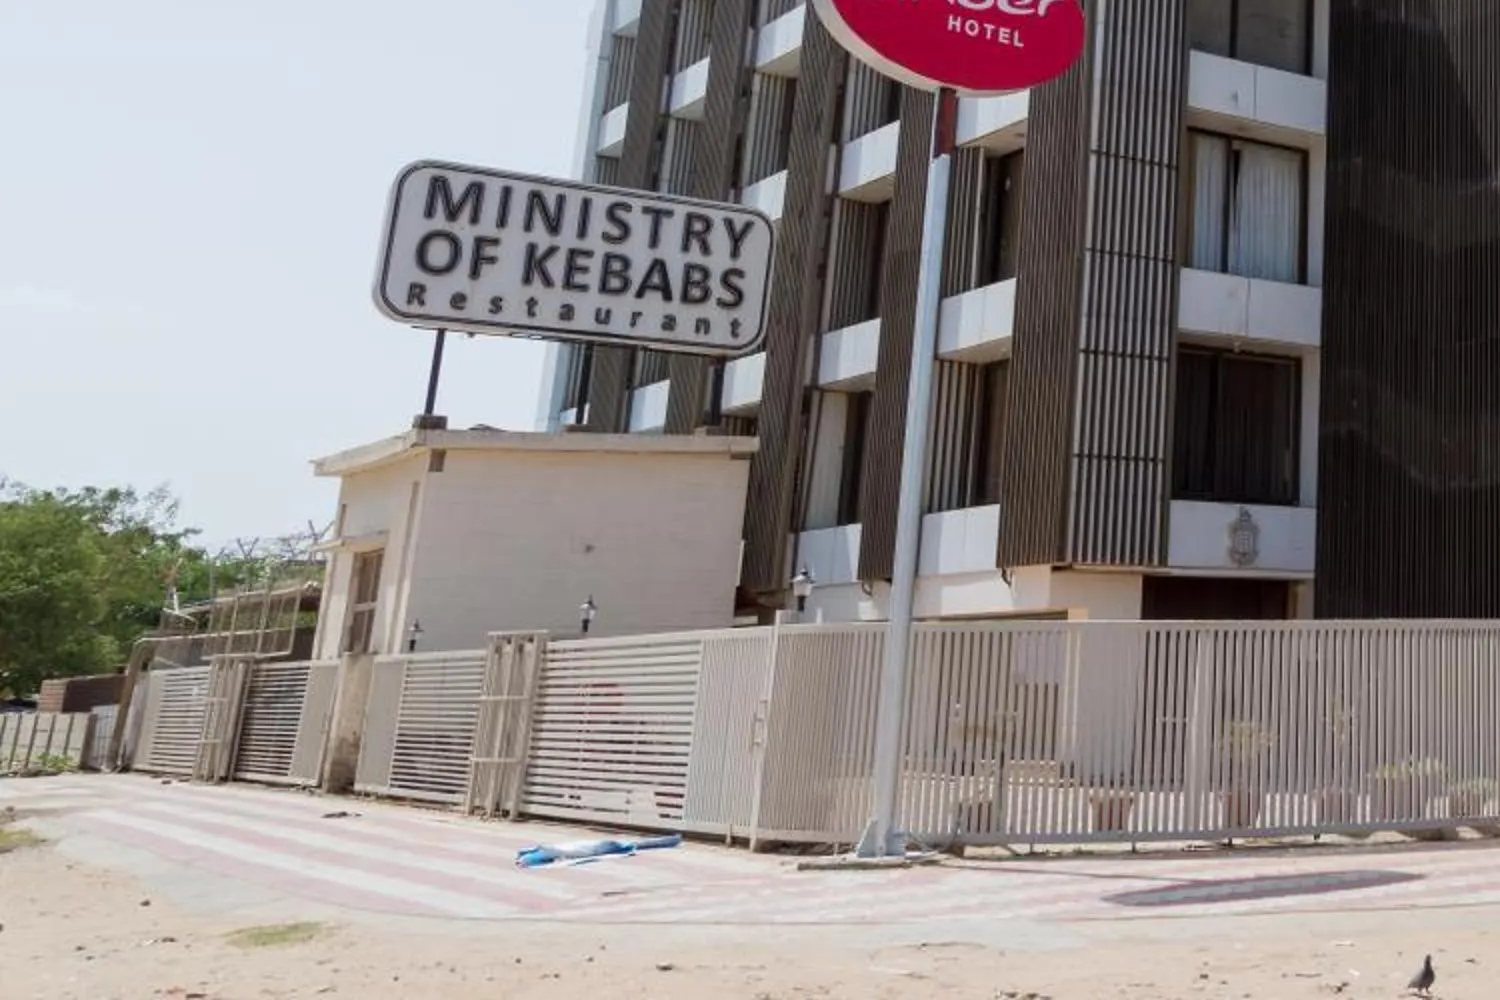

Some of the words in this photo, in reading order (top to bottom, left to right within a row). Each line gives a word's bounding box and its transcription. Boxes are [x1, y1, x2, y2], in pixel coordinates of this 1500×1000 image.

[947, 15, 1024, 48] HOTEL
[423, 175, 755, 261] MINISTRY
[415, 228, 500, 281] OF
[521, 241, 746, 309] KEBABS
[406, 281, 743, 339] Restaurant
